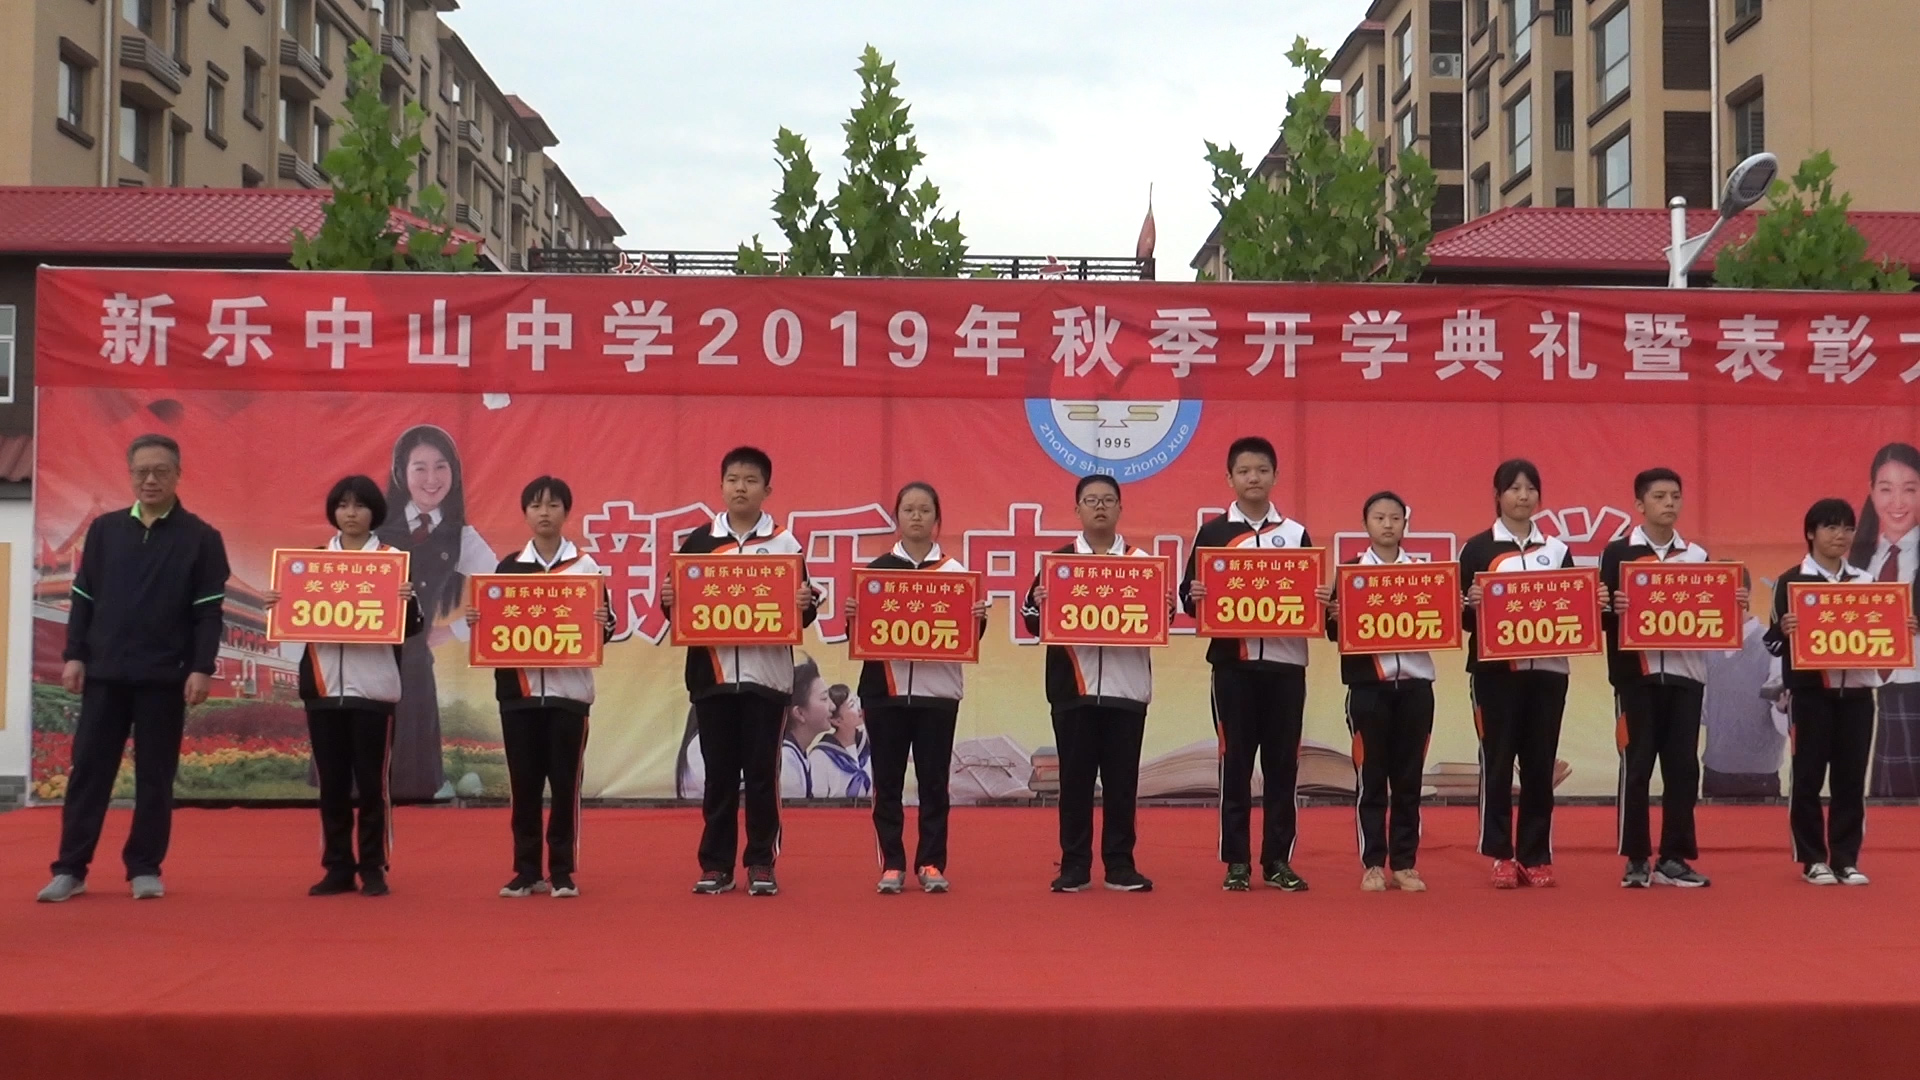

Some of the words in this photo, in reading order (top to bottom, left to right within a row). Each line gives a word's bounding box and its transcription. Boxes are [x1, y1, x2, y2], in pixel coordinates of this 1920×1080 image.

[1039, 422, 1078, 466] zhong
[1079, 459, 1115, 477] shan
[1123, 449, 1168, 477] zhong
[1167, 423, 1190, 452] xue
[1096, 437, 1132, 449] 1995
[307, 562, 392, 576] 新乐中山中学
[1229, 559, 1309, 572] 新乐中山中学
[704, 566, 786, 579] 新乐中山中学
[1074, 567, 1153, 579] 新乐中山中学
[1227, 577, 1295, 590] 奖学金
[1369, 575, 1444, 588] 新乐中山中学
[1652, 574, 1726, 585] 新乐中山中学
[304, 580, 376, 595] 奖学金
[505, 586, 588, 599] 新乐中山中学
[702, 584, 771, 597] 奖学金
[884, 582, 965, 594] 新乐中山中学
[1072, 585, 1138, 598] 奖学金
[1508, 581, 1583, 595] 新乐中山中学
[1368, 593, 1430, 606] 奖学金
[1650, 592, 1712, 603] 奖学金
[1820, 594, 1895, 605] 新乐中山中学
[502, 604, 573, 618] 奖学金
[882, 600, 950, 613] 奖学金
[1217, 596, 1305, 626] 300元
[1508, 599, 1570, 612] 奖学金
[291, 600, 385, 631] 300元
[692, 603, 781, 633] 300元
[1061, 604, 1148, 634] 300元
[1819, 611, 1882, 623] 奖学金
[1359, 611, 1441, 639] 300元
[1640, 610, 1723, 638] 300元
[871, 620, 958, 649] 300元
[1498, 616, 1581, 646] 300元
[491, 623, 583, 655] 300元
[1811, 629, 1894, 657] 300元
